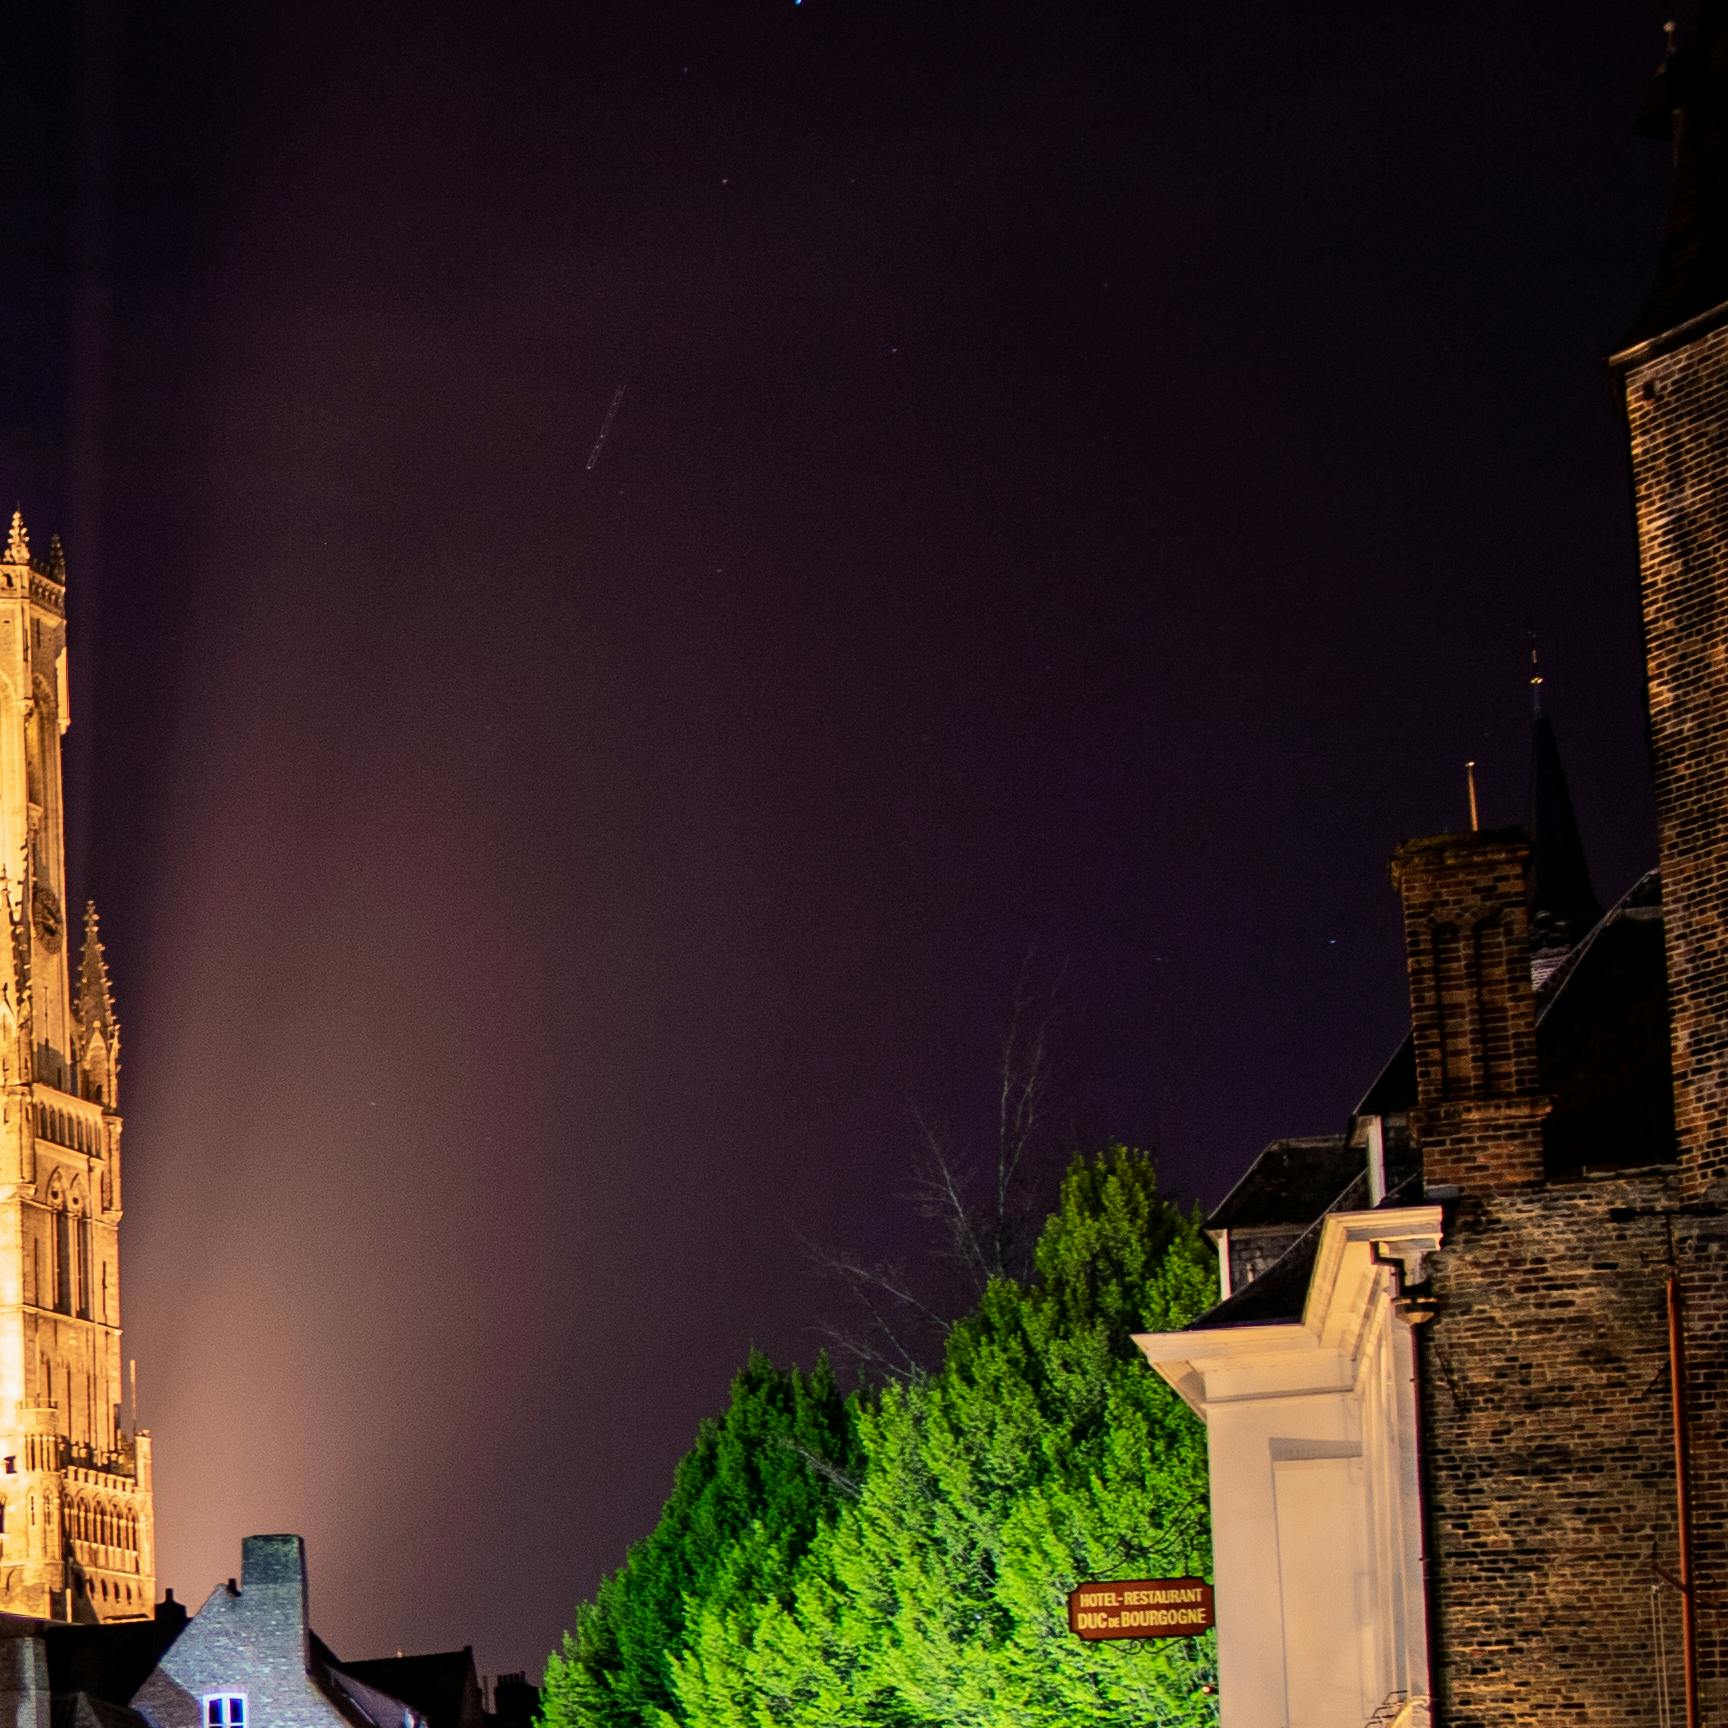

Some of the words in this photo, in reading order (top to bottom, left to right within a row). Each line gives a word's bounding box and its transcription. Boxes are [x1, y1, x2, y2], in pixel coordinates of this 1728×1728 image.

[1077, 1612, 1107, 1630] DUC
[1109, 1617, 1120, 1628] DE
[1121, 1608, 1206, 1627] BOURGOGNE
